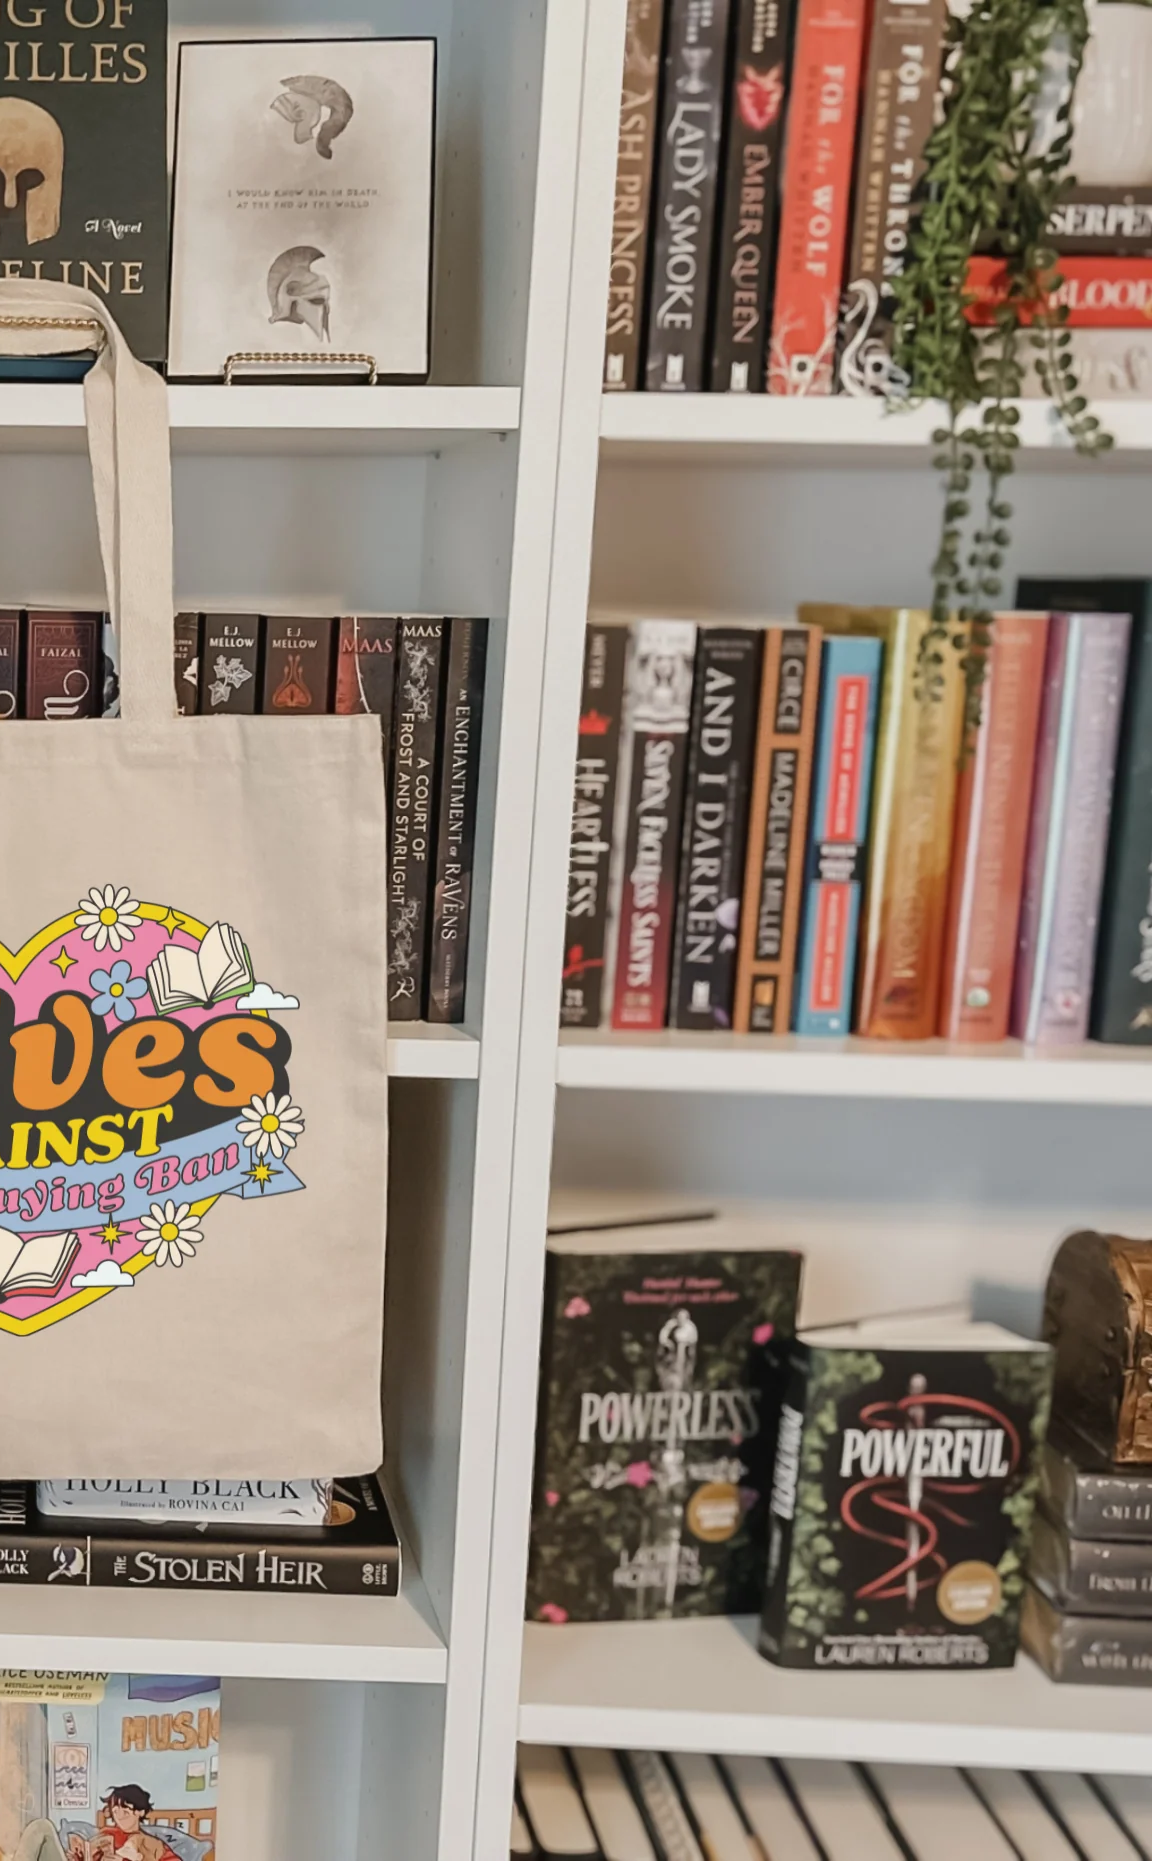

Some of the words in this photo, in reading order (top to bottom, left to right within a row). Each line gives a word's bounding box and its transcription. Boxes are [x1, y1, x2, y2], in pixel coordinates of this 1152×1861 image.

[64, 0, 134, 29] OF
[817, 63, 846, 126] FOR
[897, 44, 925, 105] FOR
[617, 89, 654, 162] ASH
[666, 101, 714, 200] LADY
[732, 143, 771, 243] EMBER
[101, 218, 142, 240] Novel
[605, 174, 644, 337] PRINCESS
[804, 184, 834, 279] WOLF
[656, 203, 701, 331] SMOKE
[730, 243, 762, 344] QUEEN
[40, 648, 83, 658] FAIZAL
[209, 637, 255, 648] MELLOW
[224, 627, 241, 636] E.J.
[272, 639, 318, 650] MELLOW
[286, 627, 302, 637] E.J.
[342, 638, 393, 653] MAAS
[402, 625, 443, 638] MAAS
[459, 688, 468, 701] AN
[700, 666, 735, 757] AND
[776, 658, 805, 731] CIRCE
[399, 712, 416, 767] FROST
[416, 757, 432, 769] A
[396, 772, 412, 810] AND
[448, 705, 471, 844] ENCHANTMENT
[696, 771, 728, 786] I
[413, 774, 431, 833] COURT
[391, 815, 410, 905] STARLIGHT
[411, 837, 426, 861] OF
[566, 757, 611, 919] HEARTLESS
[629, 816, 669, 911] FACELESS
[441, 862, 466, 941] RAVENS
[685, 802, 726, 965] DARKEN
[626, 911, 661, 988] SAINTS
[134, 1143, 240, 1197] Ban
[578, 1388, 761, 1444] POWERLESS
[838, 1427, 1010, 1478] POWERFUL
[168, 1499, 218, 1511] ROVINA
[221, 1500, 245, 1512] CAI
[114, 1554, 127, 1577] THE
[128, 1550, 246, 1584] STOLEN
[255, 1548, 328, 1590] HEIR
